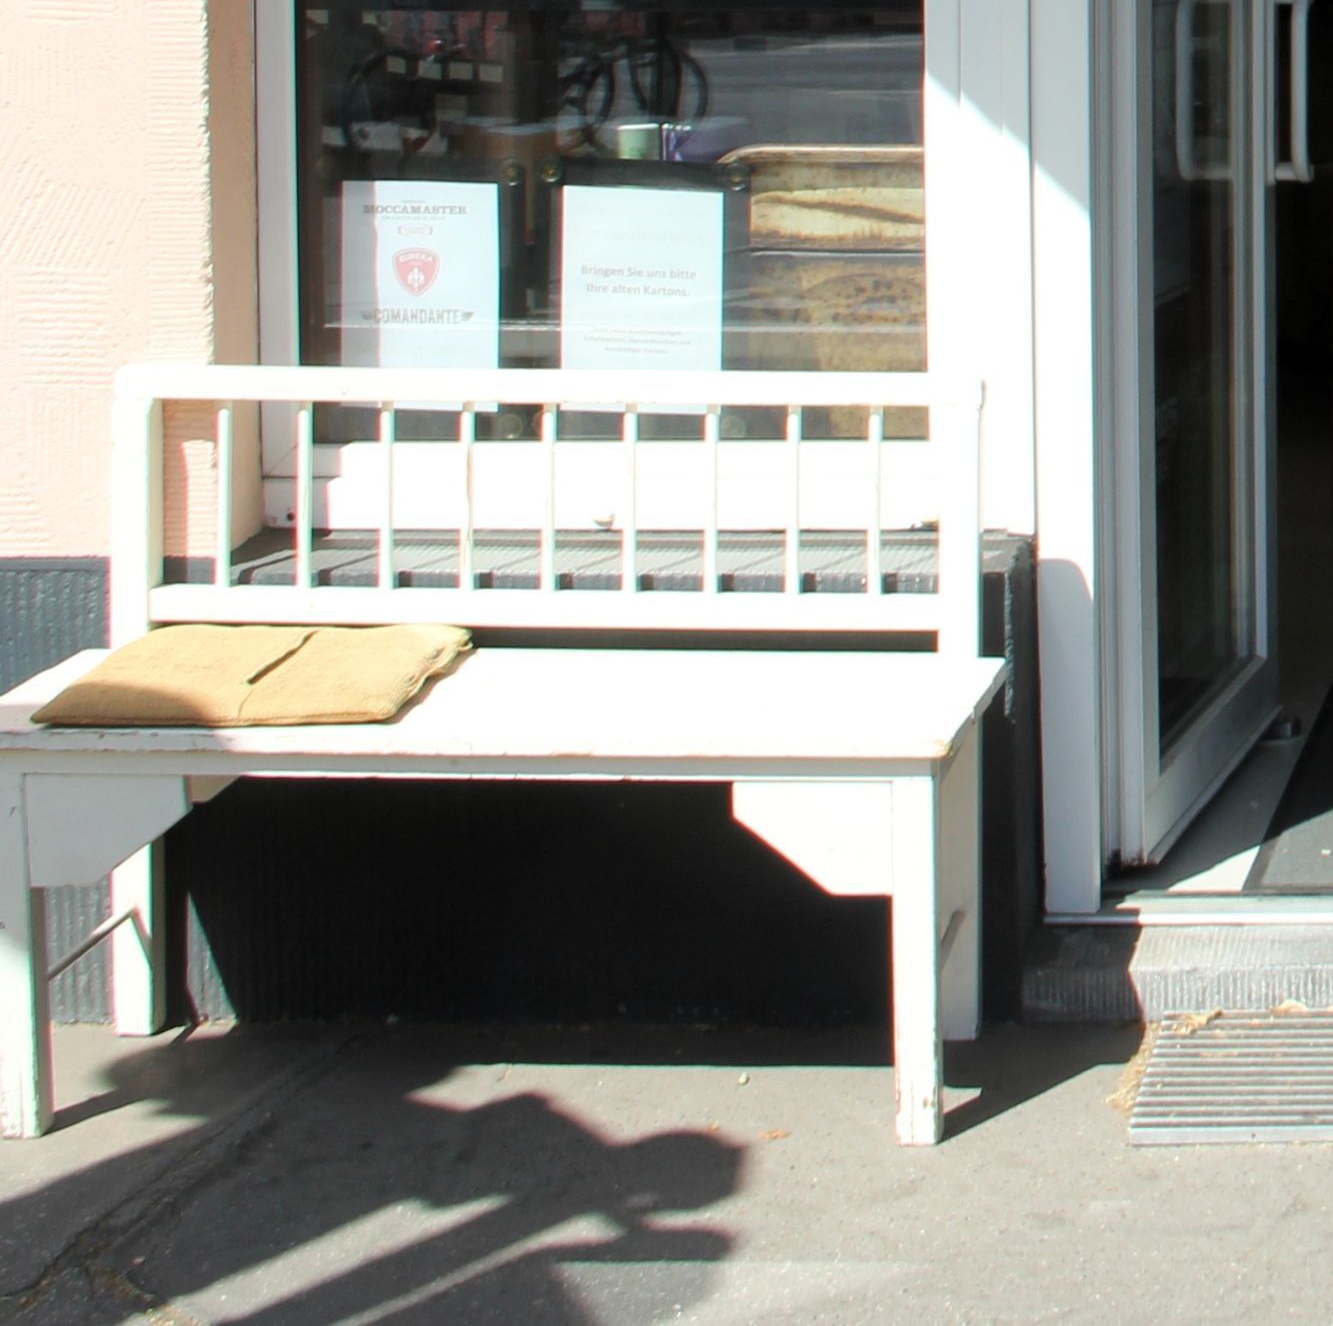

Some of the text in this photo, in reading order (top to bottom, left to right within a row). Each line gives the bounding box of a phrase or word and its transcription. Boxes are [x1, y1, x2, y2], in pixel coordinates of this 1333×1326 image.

[363, 204, 468, 215] MOCCAMASTER
[580, 265, 697, 279] Bringen Sie uns bitte
[586, 282, 690, 297] Ihre alten Kartons.
[373, 308, 461, 325] COMANDANTE
